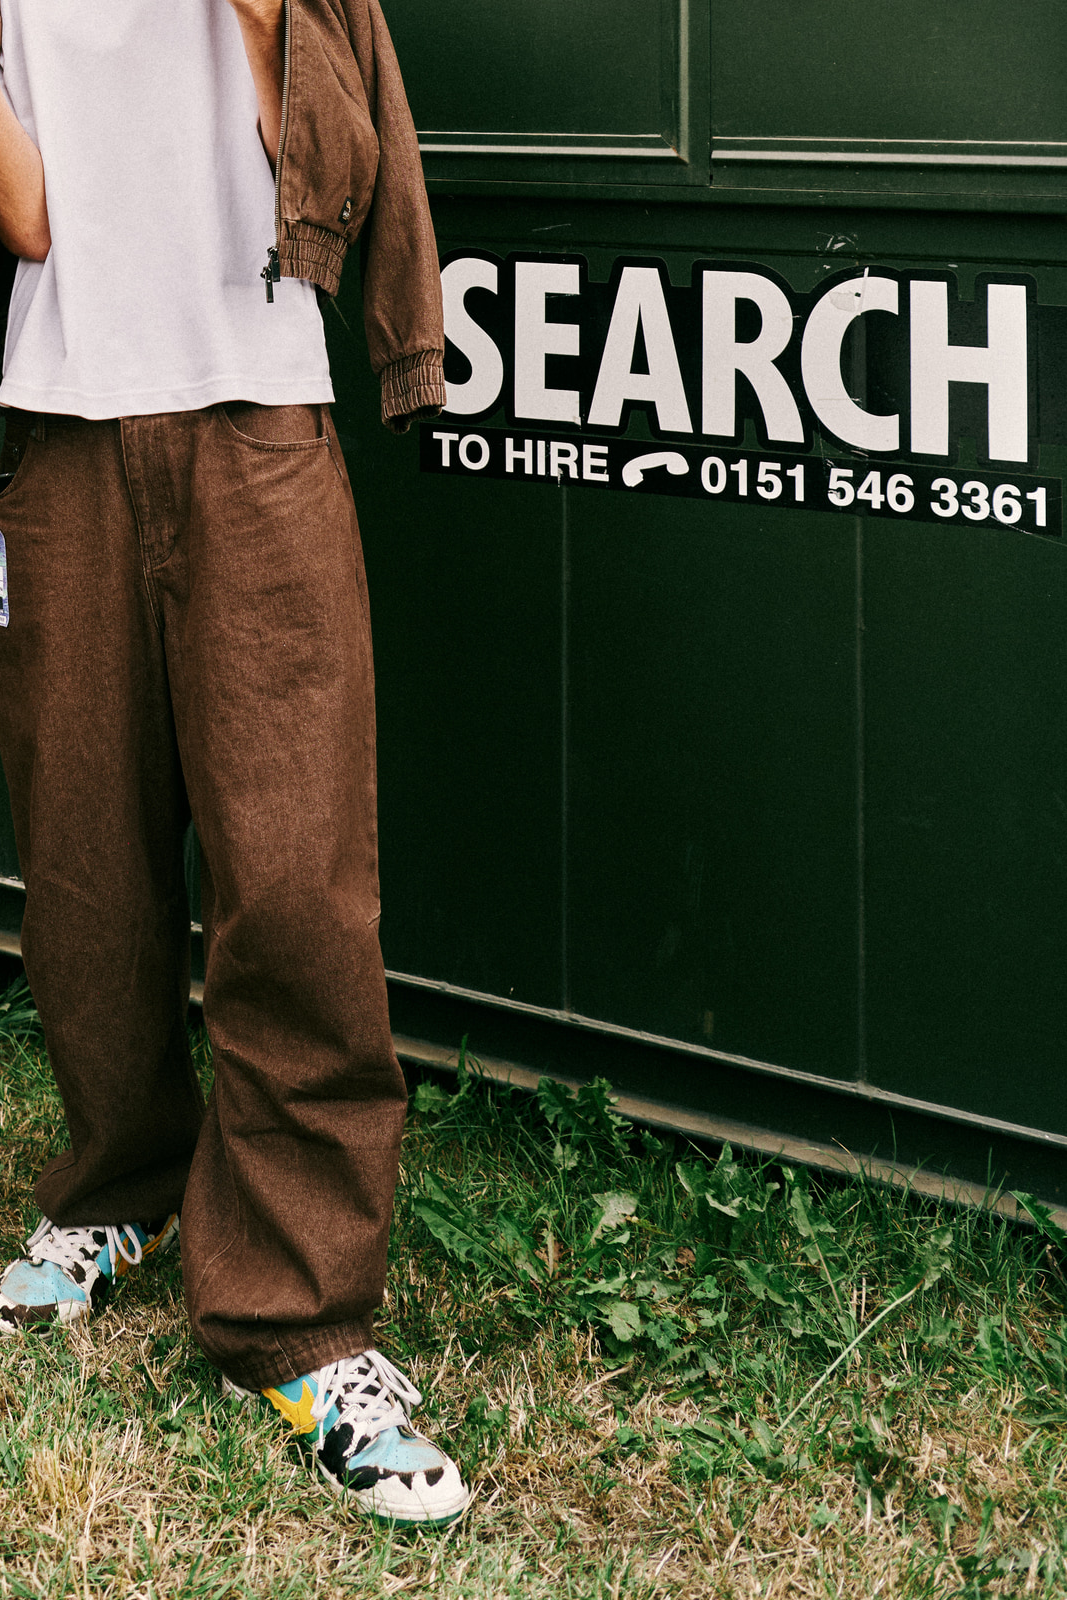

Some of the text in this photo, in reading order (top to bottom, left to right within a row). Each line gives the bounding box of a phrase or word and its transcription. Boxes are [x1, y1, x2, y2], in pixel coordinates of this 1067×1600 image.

[440, 257, 1028, 463] SEARCH
[433, 431, 1047, 527] TO HIRE 0151 546 3361
